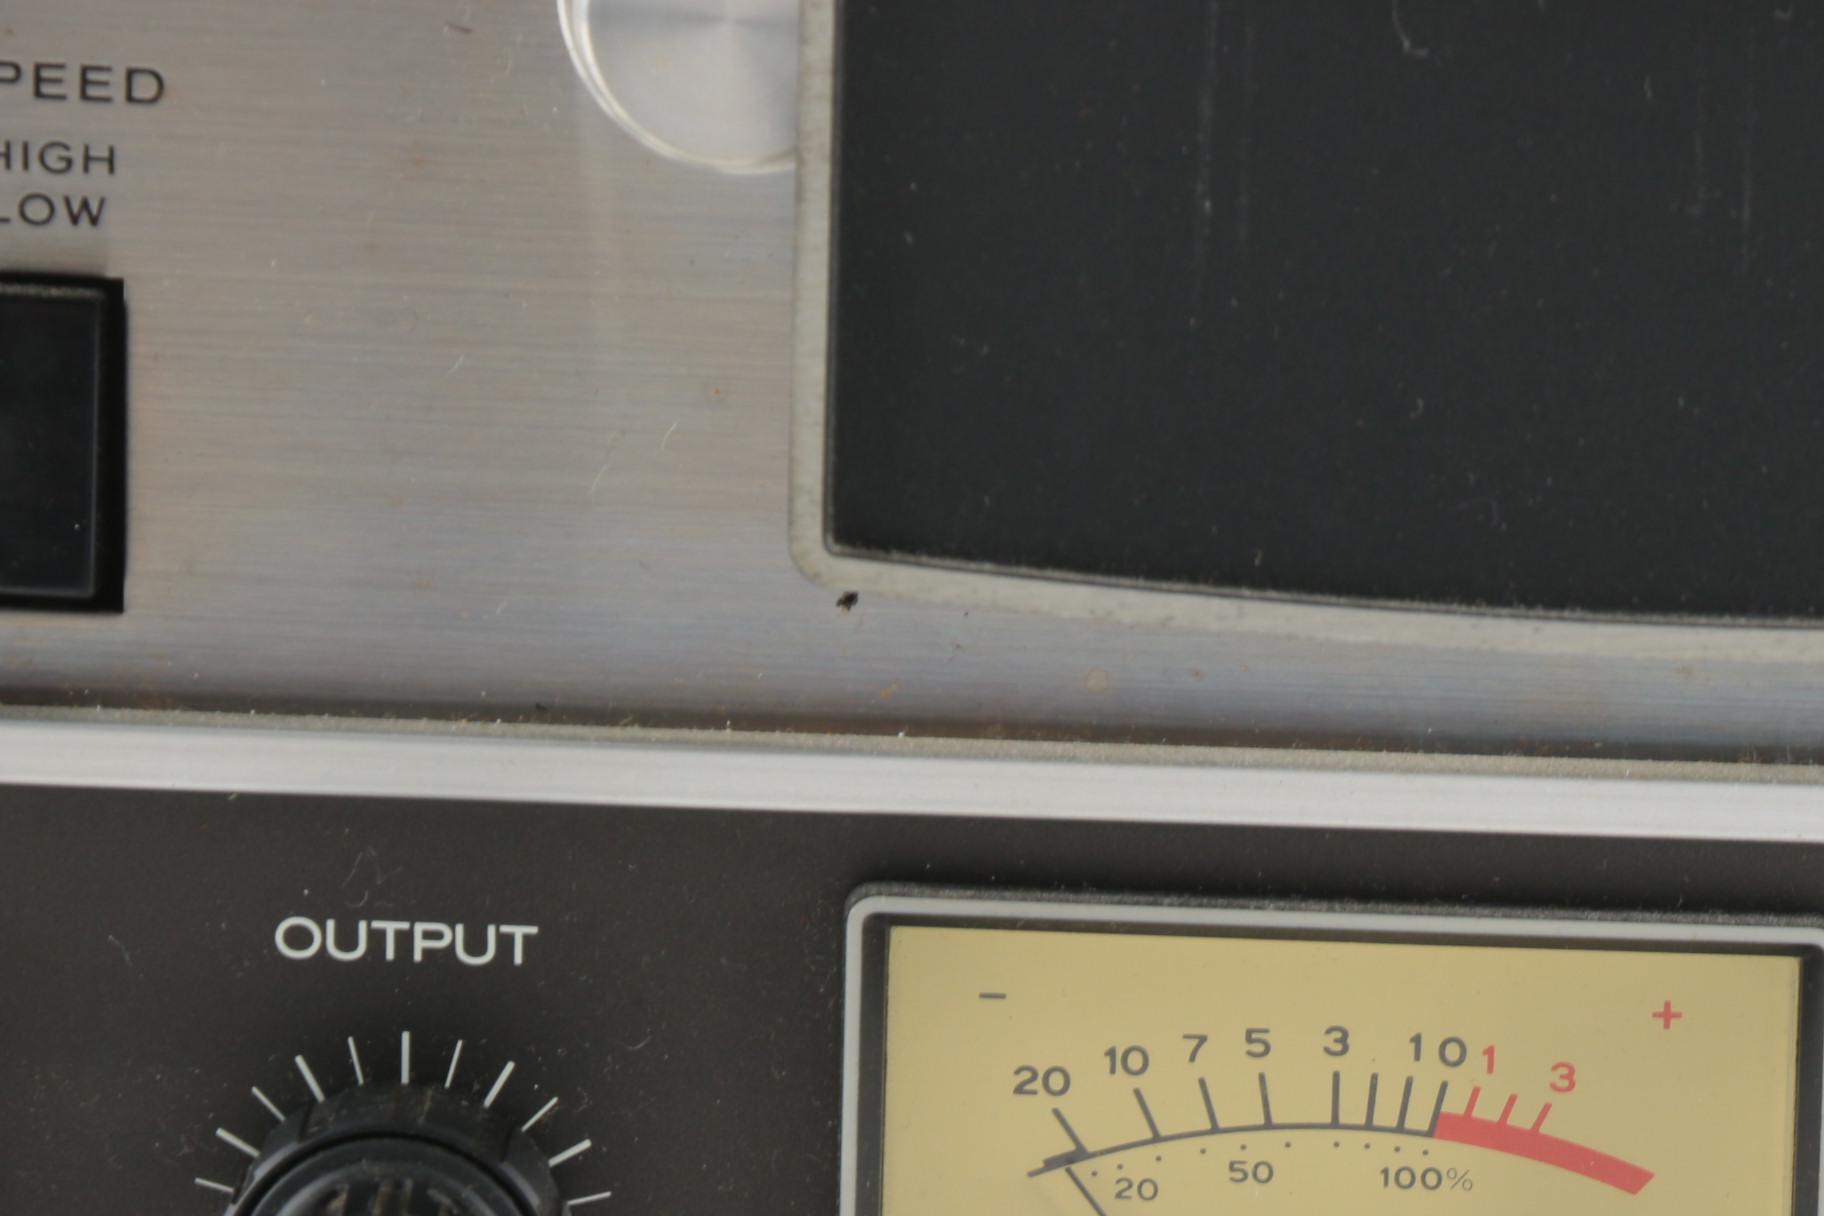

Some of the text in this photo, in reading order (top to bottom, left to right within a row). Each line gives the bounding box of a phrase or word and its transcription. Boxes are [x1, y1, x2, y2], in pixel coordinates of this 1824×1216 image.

[273, 915, 540, 967] OUTPUT
[1011, 1064, 1072, 1097] 20
[1102, 1044, 1150, 1077] 10
[1181, 1033, 1209, 1063] 7
[1244, 1027, 1272, 1059] 5
[1322, 1025, 1351, 1058] 3
[1548, 1061, 1577, 1094] 3
[1113, 1160, 1474, 1202] 20 50 100%
